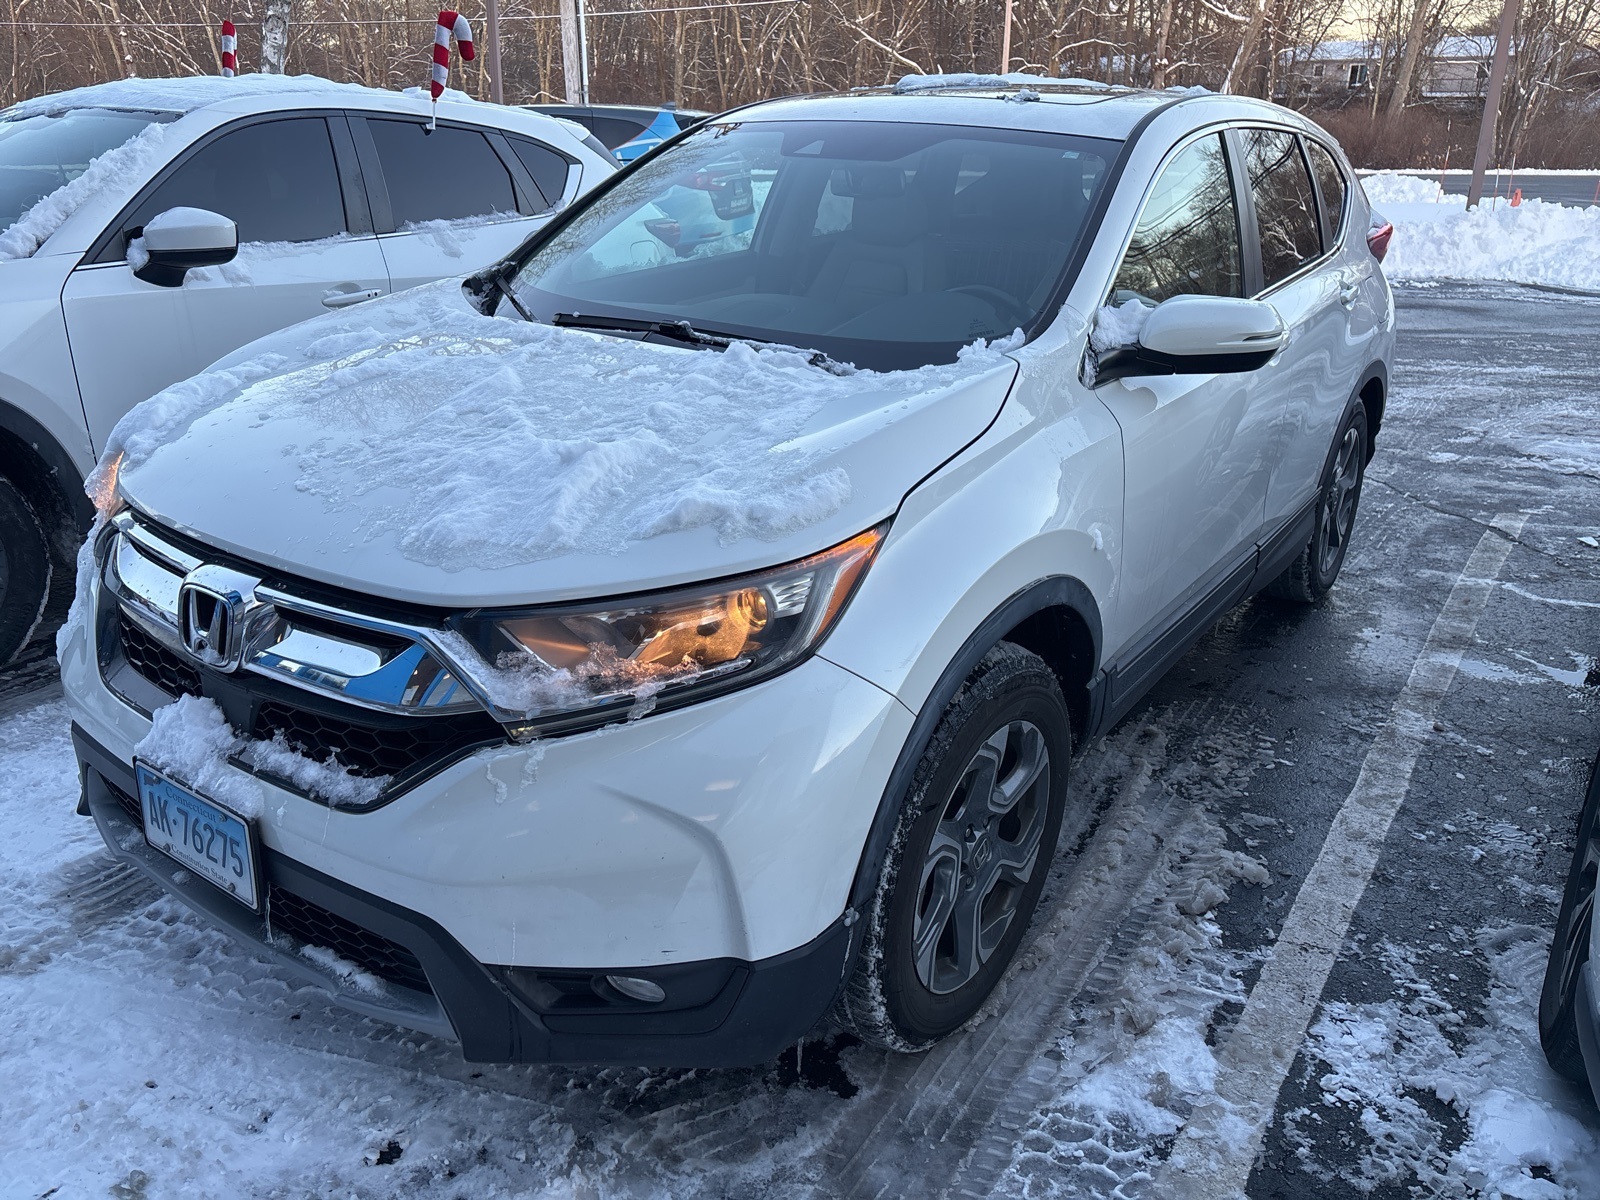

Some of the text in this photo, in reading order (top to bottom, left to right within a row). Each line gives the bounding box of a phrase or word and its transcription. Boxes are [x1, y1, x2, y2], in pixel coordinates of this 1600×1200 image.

[165, 786, 217, 823] Connecticut
[171, 843, 228, 884] Constitution State
